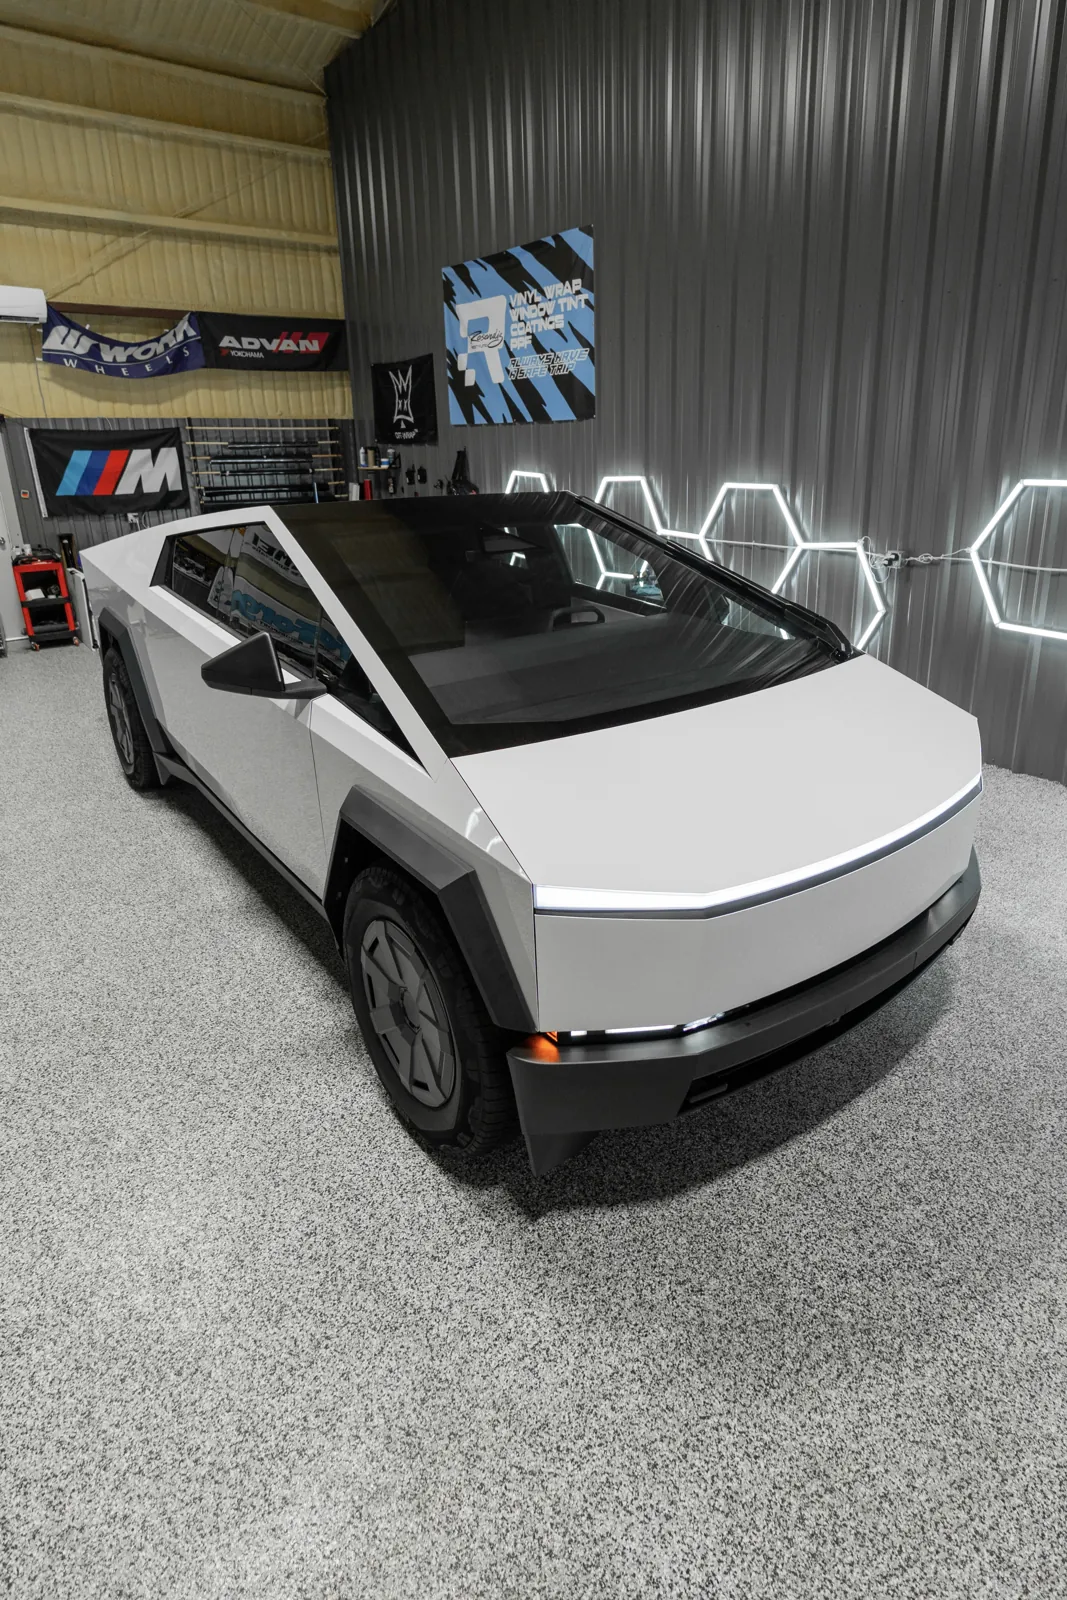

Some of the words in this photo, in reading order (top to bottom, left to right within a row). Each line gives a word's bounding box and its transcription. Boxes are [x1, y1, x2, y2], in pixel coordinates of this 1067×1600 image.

[509, 289, 542, 308] VINYL
[543, 278, 583, 299] WRAP
[509, 300, 557, 323] WINDOW
[557, 293, 589, 313] TINT
[510, 314, 565, 337] COATINGS
[219, 335, 321, 352] ADVAN
[510, 335, 533, 351] PPF
[63, 346, 190, 376] WHEELS
[230, 350, 265, 359] YOKOHAMA
[508, 352, 554, 369] ALWAYS
[553, 348, 591, 364] HAVE
[508, 367, 518, 381] A
[517, 365, 548, 380] SAFE
[549, 362, 577, 376] TRIP
